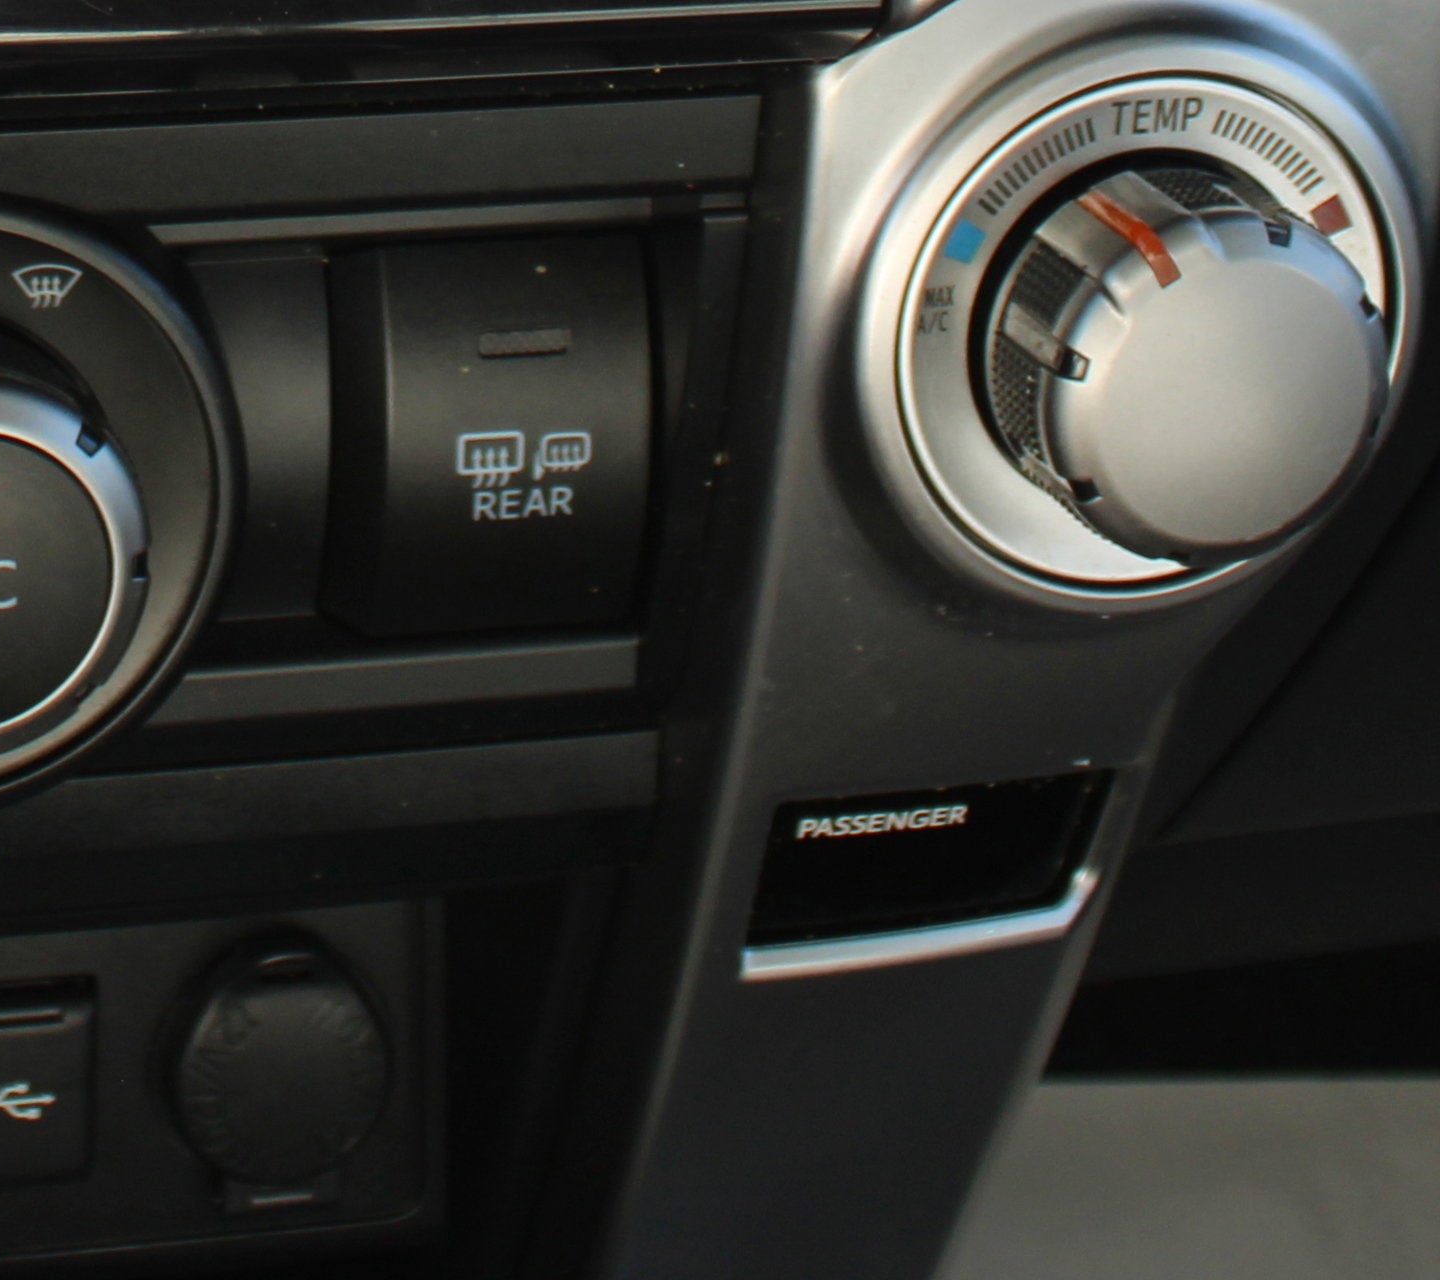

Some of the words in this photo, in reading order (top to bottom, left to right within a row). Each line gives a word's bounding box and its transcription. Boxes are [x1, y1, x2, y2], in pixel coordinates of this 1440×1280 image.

[1111, 96, 1204, 136] TEMP
[472, 486, 574, 522] REAR
[796, 804, 969, 840] PASSENGER
